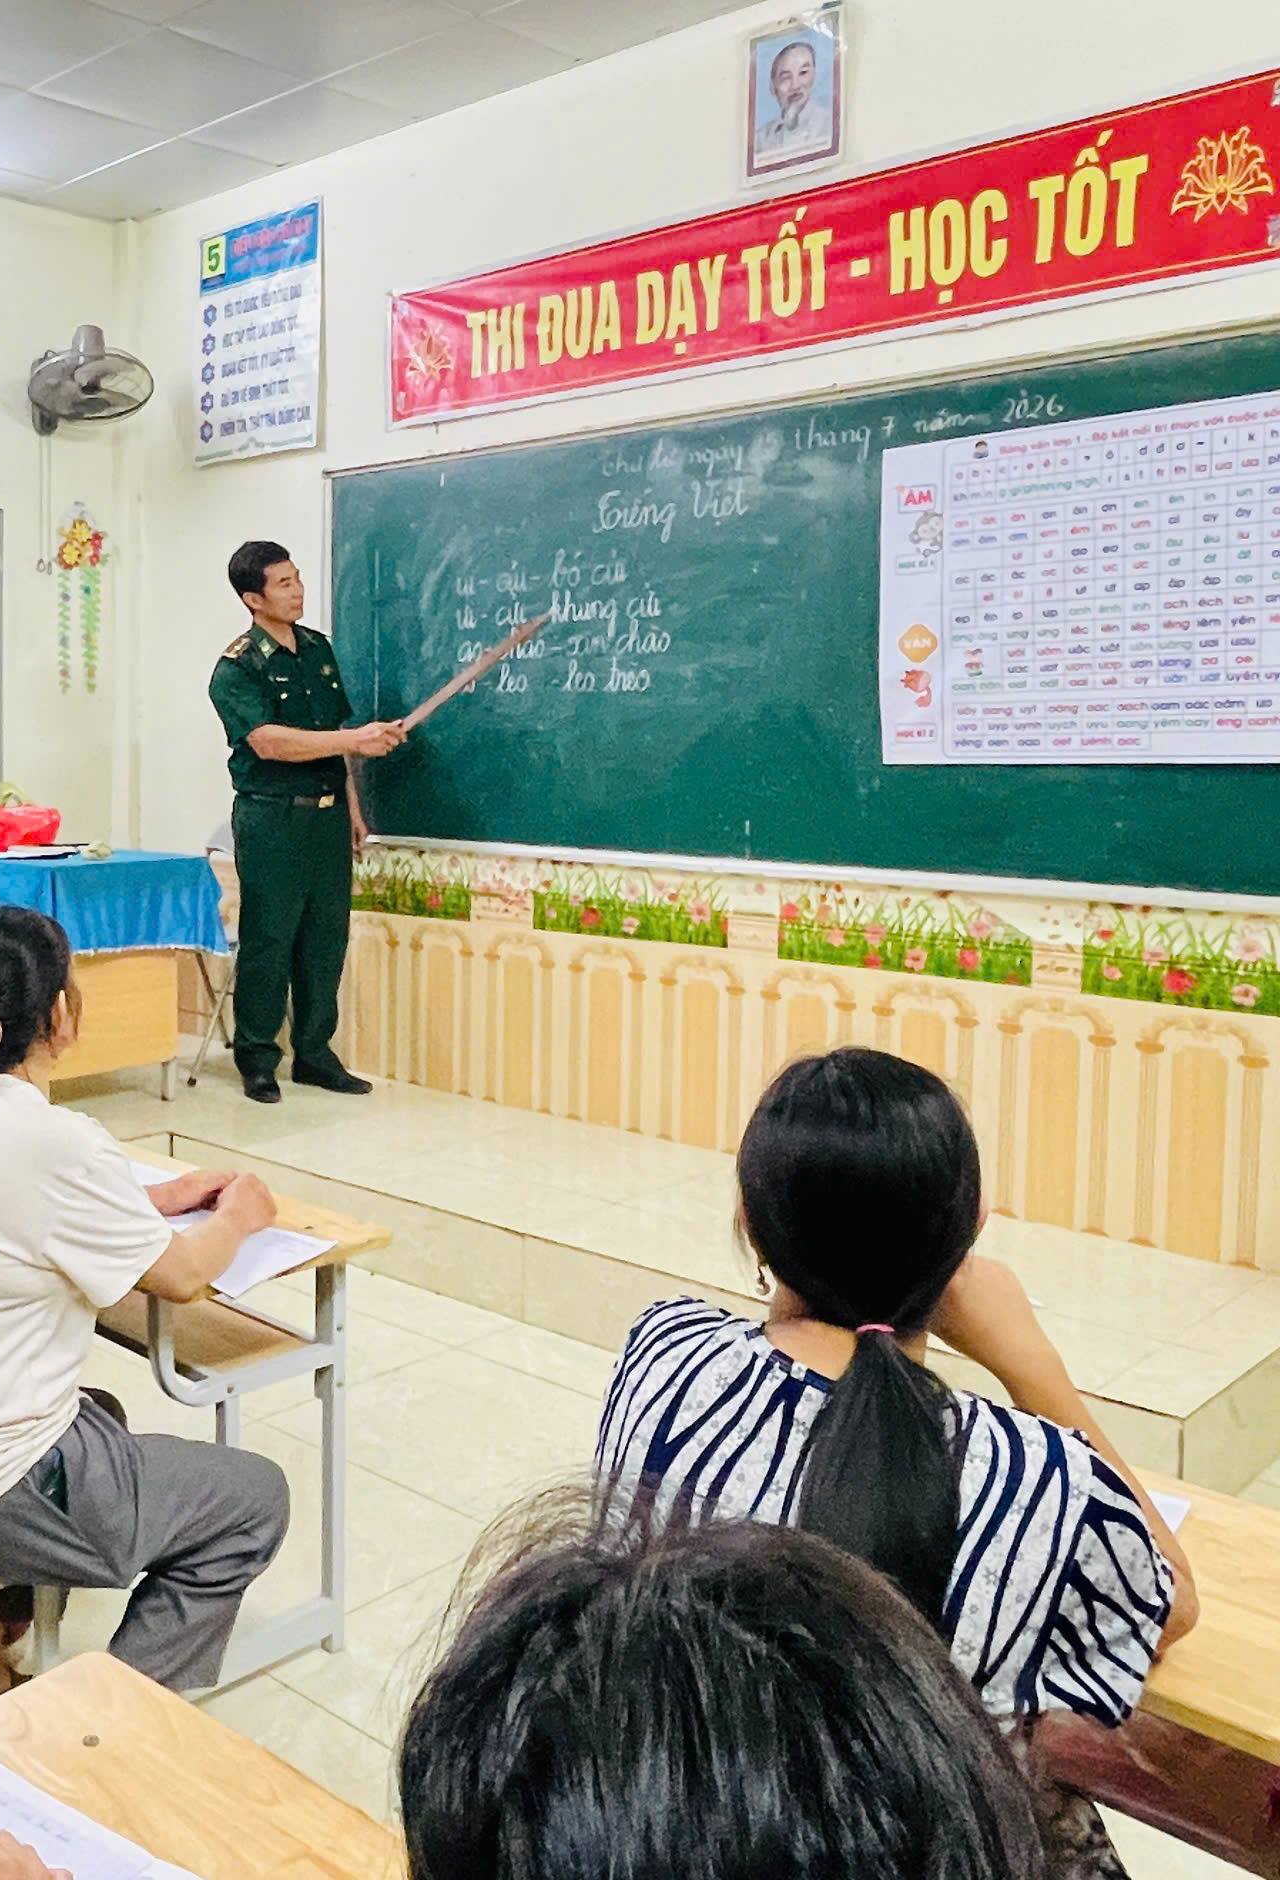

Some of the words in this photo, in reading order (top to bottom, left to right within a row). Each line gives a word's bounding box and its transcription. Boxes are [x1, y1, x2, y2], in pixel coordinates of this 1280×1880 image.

[207, 243, 220, 271] 5
[466, 302, 526, 379] THI
[536, 280, 622, 366] ĐUA
[635, 254, 728, 355] DẠY
[741, 206, 833, 323] TỐT
[889, 189, 1008, 304] HỌC
[1028, 129, 1149, 264] TỐT
[881, 416, 895, 436] 7
[1002, 390, 1064, 423] 2026
[496, 664, 527, 693] leo
